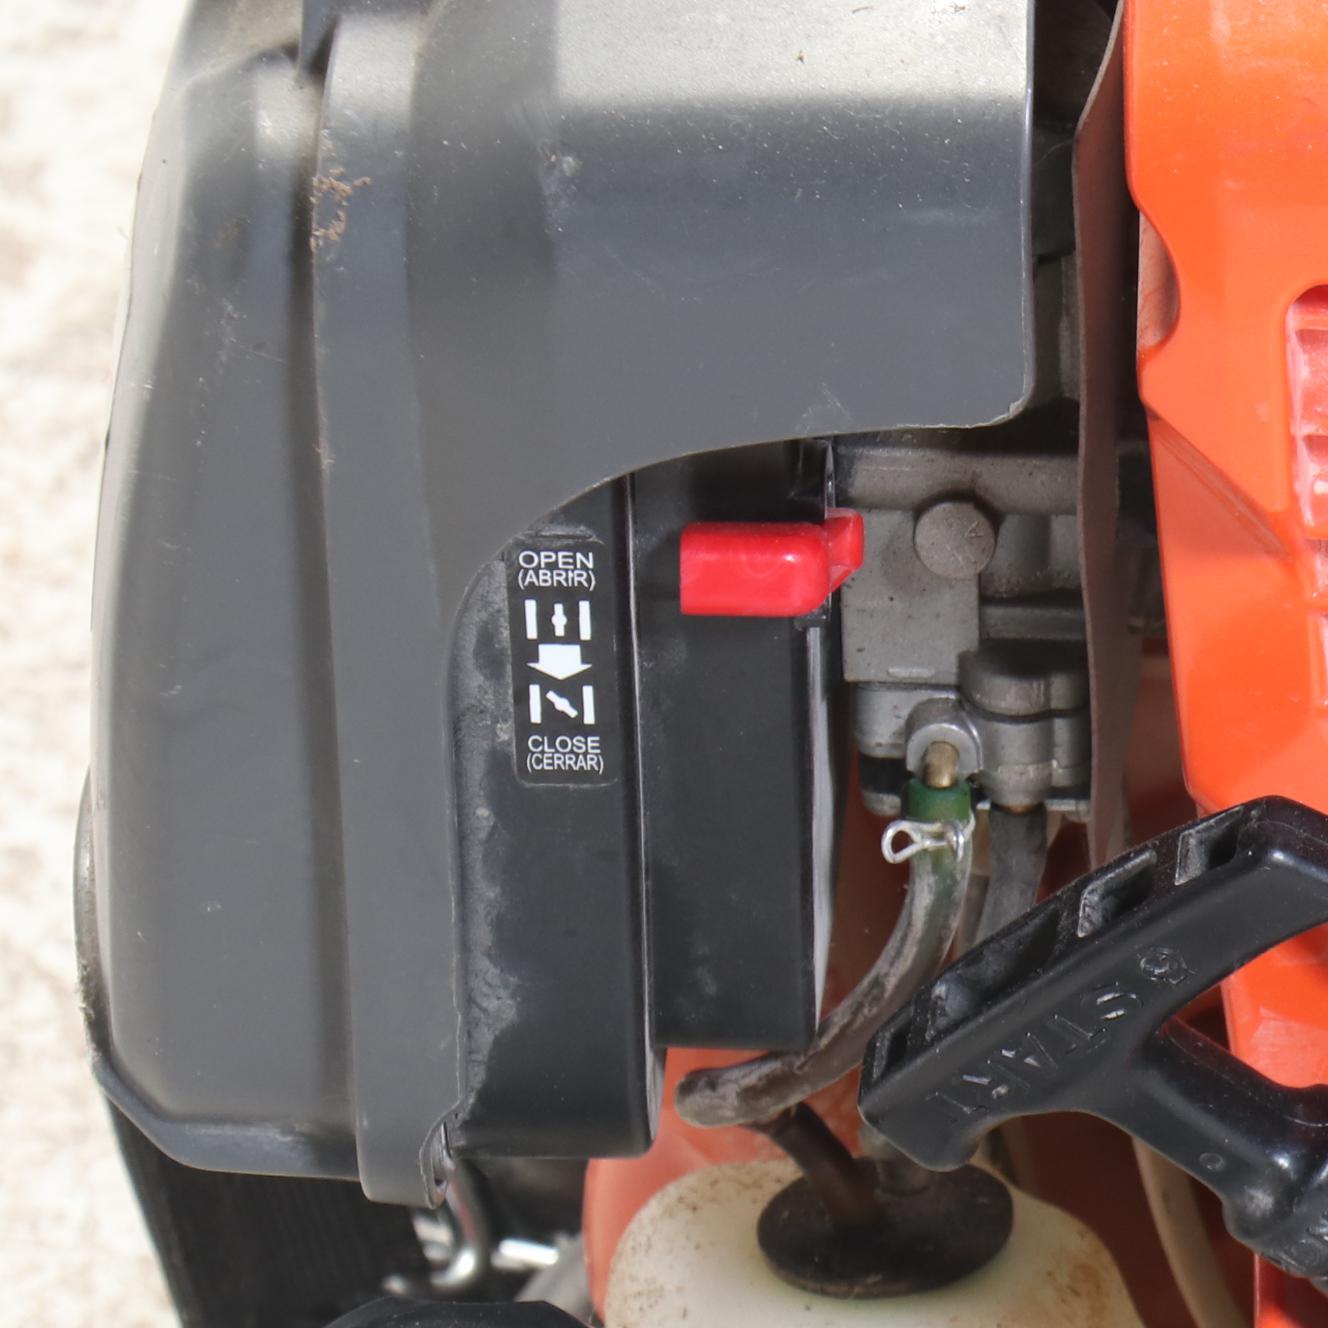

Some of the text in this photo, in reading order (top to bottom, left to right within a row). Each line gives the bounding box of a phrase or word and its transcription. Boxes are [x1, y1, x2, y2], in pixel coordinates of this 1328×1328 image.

[518, 551, 594, 569] OPEN
[517, 569, 596, 591] (ABRIR)
[527, 735, 601, 753] CLOSE
[526, 752, 604, 774] (CERRAR)
[925, 982, 1145, 1122] START
